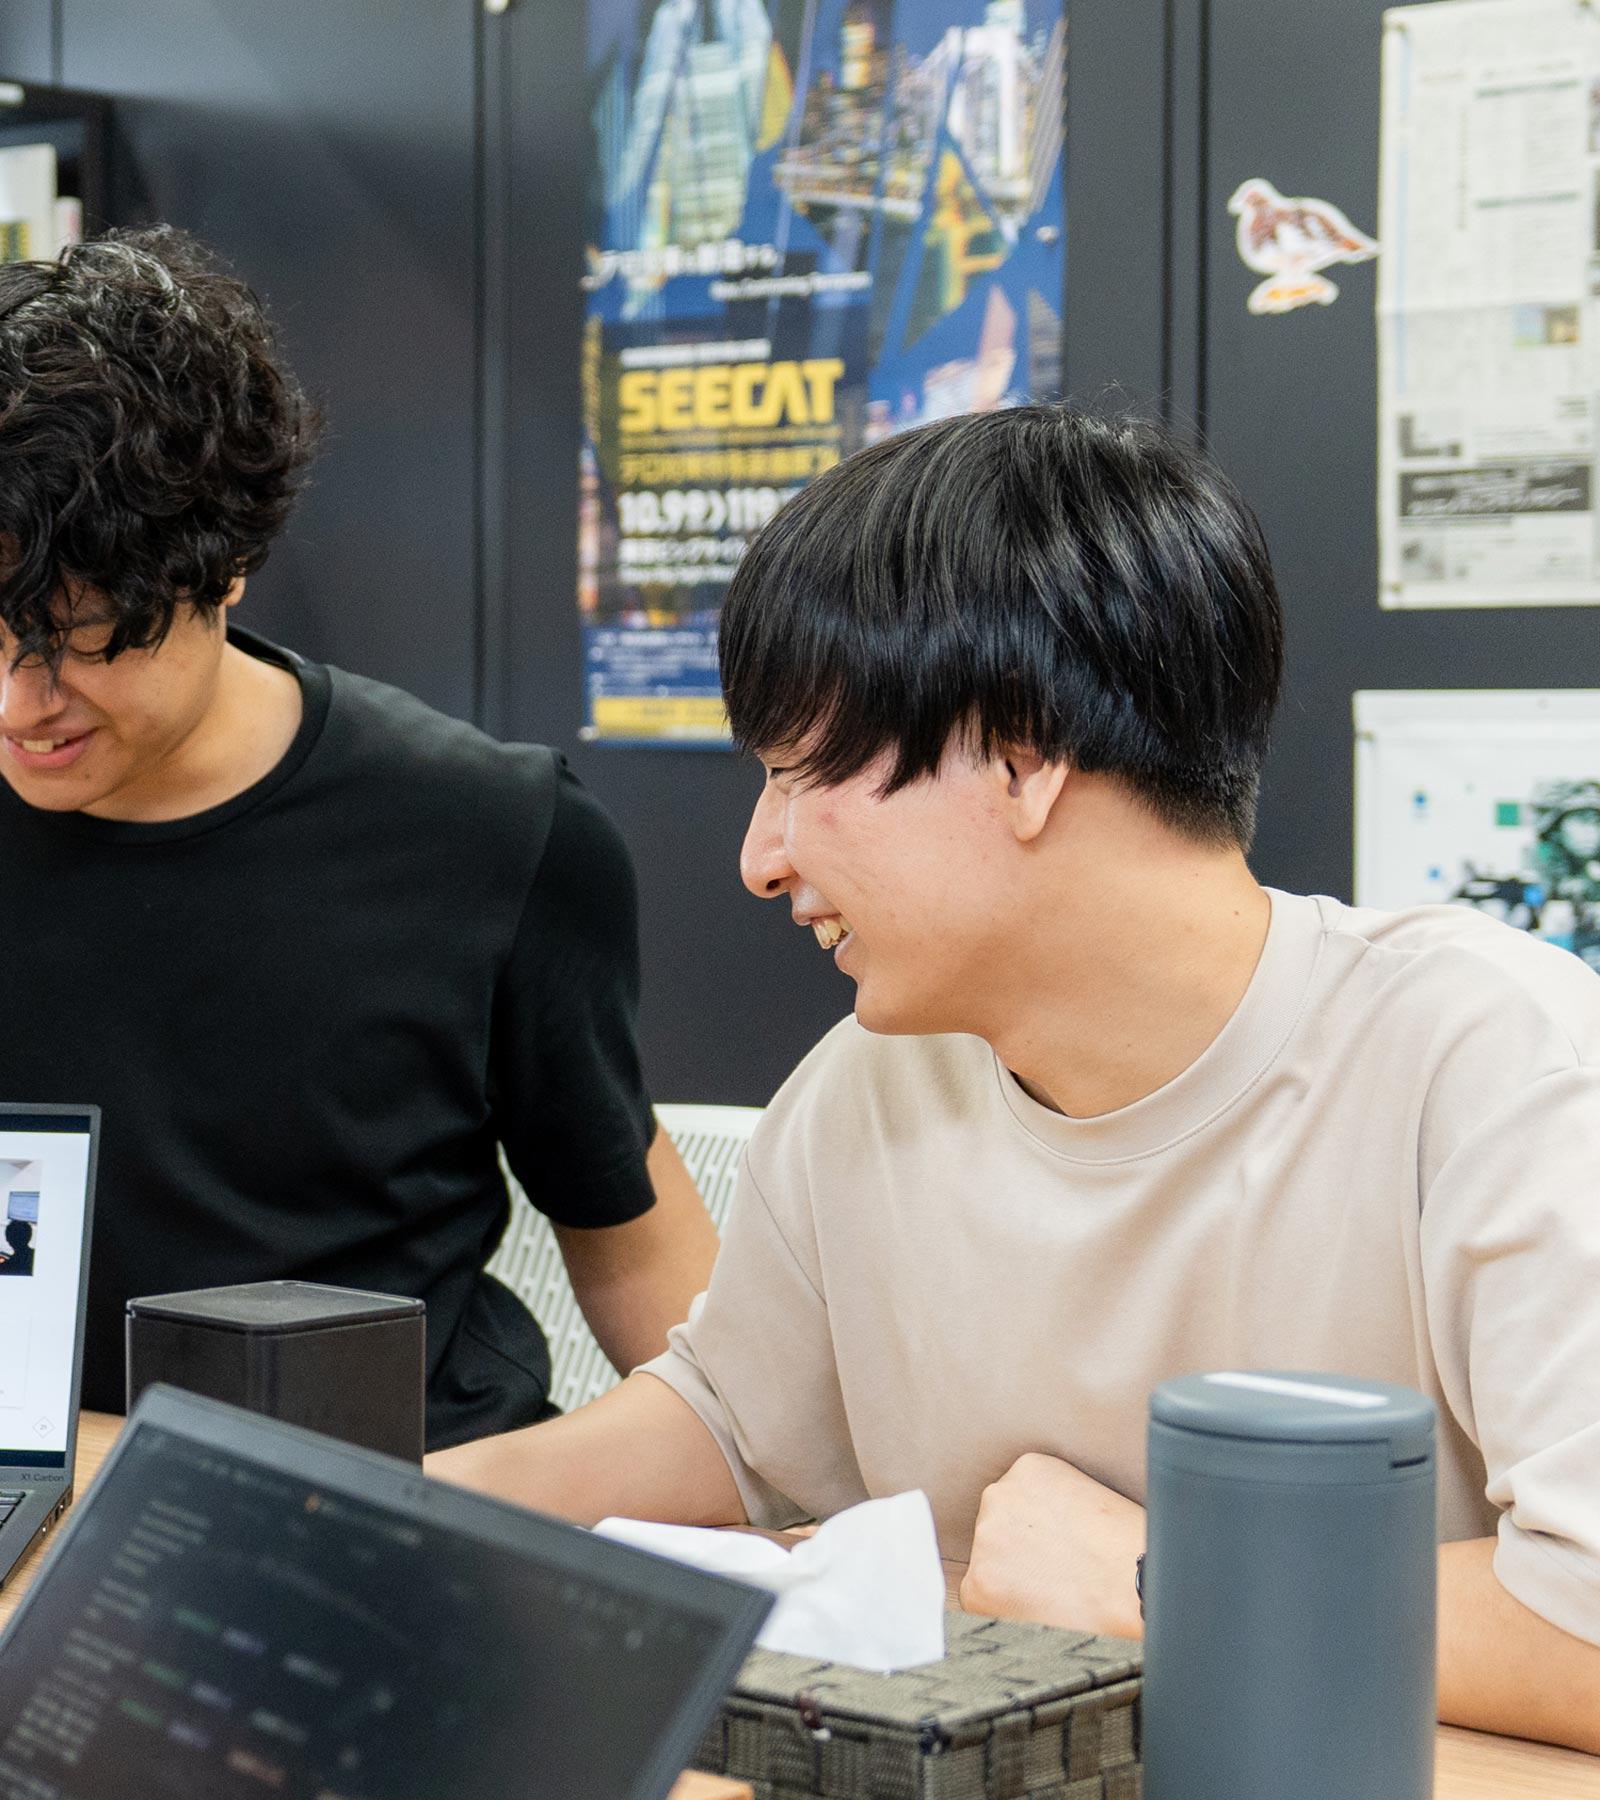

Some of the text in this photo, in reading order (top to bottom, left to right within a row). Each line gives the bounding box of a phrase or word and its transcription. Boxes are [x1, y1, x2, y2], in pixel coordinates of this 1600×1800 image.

[619, 357, 845, 433] SEECAT
[20, 1472, 65, 1482] X1 Carbon
